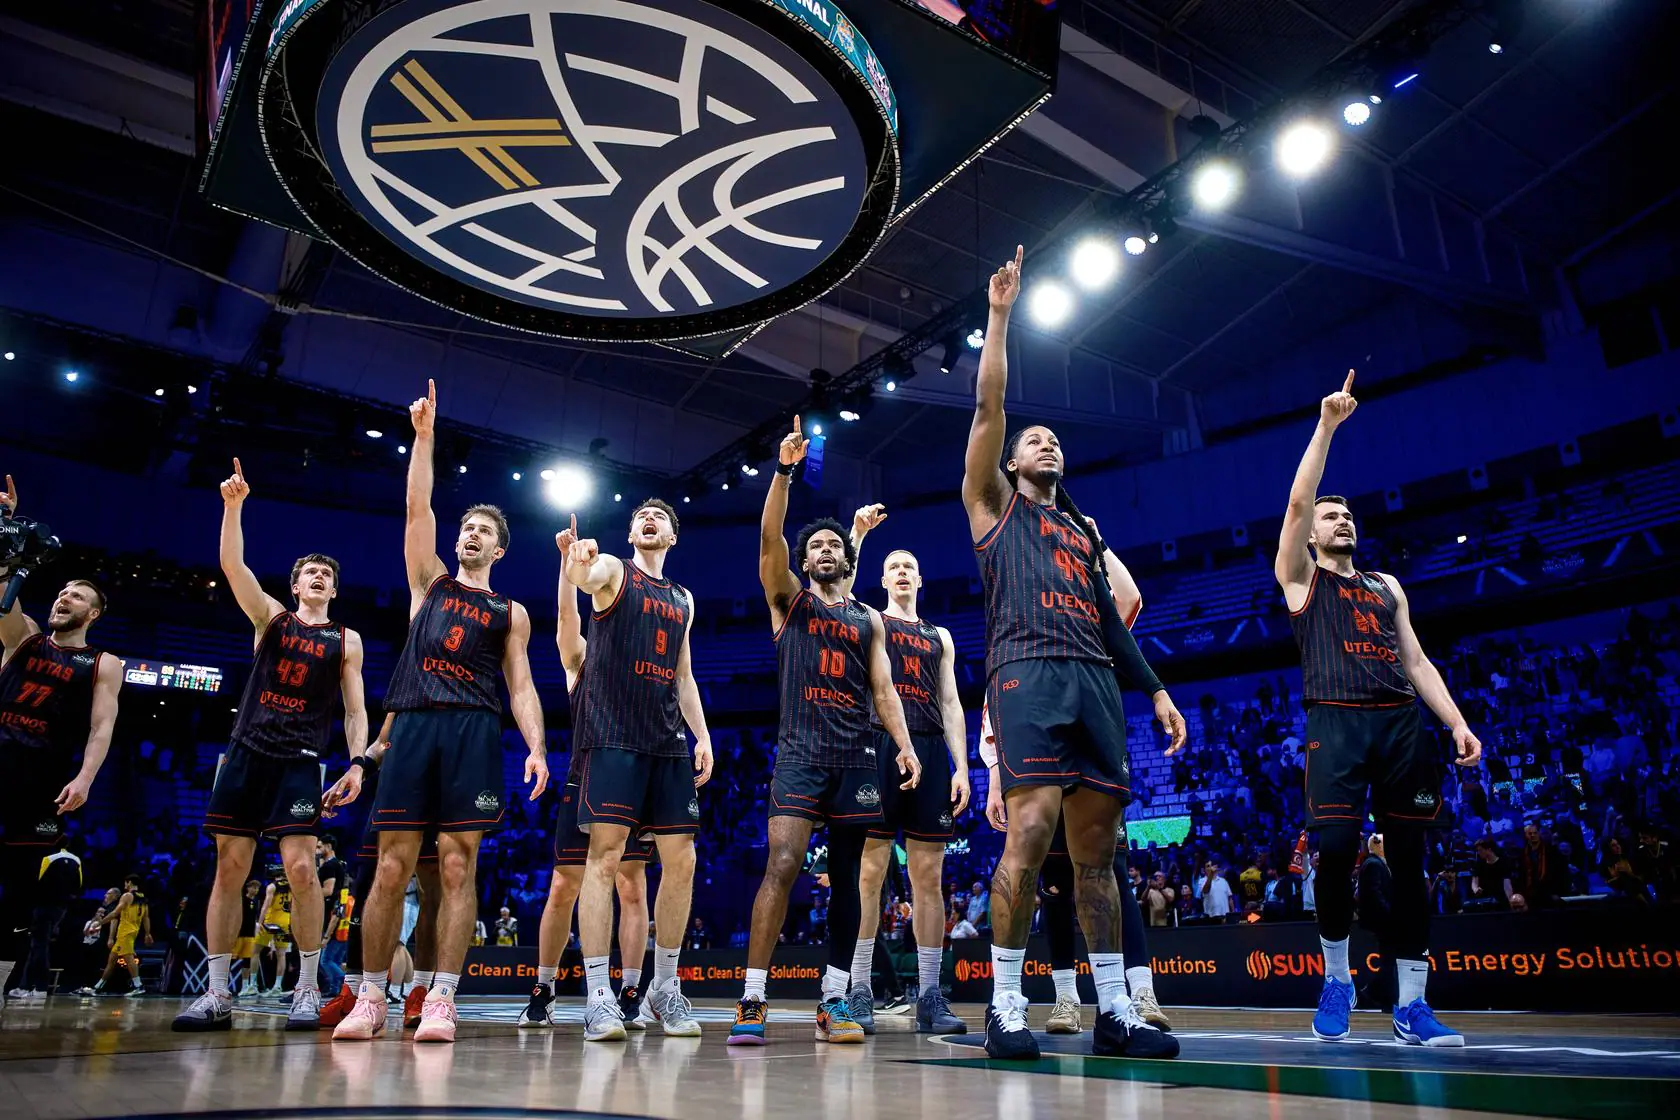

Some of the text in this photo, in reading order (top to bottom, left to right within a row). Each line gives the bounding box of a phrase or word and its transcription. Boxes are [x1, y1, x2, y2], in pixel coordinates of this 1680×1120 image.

[441, 596, 492, 627] RYTAS
[643, 596, 684, 625] RYTAS
[444, 624, 465, 652] 3
[655, 628, 668, 656] 9
[808, 618, 860, 645] RYTAS
[26, 656, 74, 681] RYTAS
[277, 659, 308, 687] 43
[423, 656, 474, 682] UTENOS
[634, 660, 675, 680] UTENO
[819, 647, 846, 678] 10
[15, 682, 53, 707] 77
[260, 691, 307, 713] UTENOS
[804, 685, 856, 708] UTENOS
[468, 963, 512, 977] Clean
[707, 966, 732, 980] Clean
[770, 965, 819, 980] Solutions
[1149, 956, 1216, 975] lutions
[1446, 951, 1546, 976] Energy
[1556, 944, 1680, 970] Solutio
